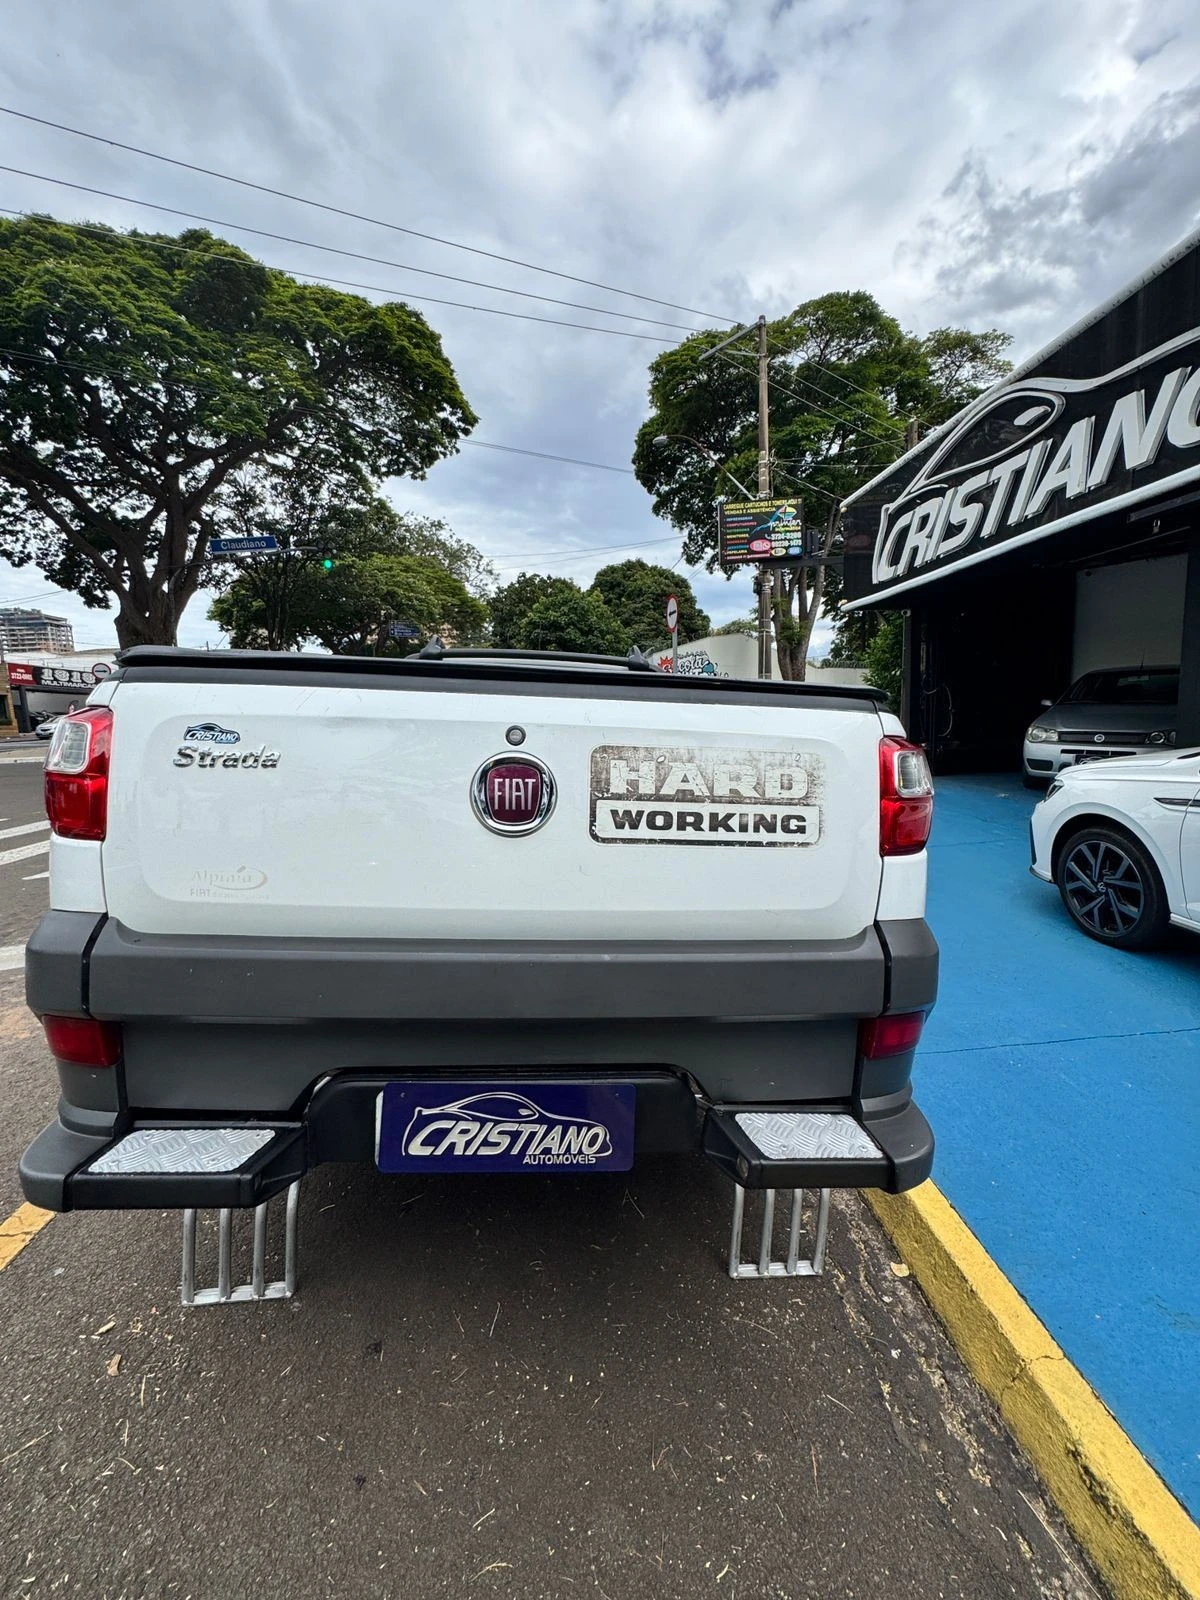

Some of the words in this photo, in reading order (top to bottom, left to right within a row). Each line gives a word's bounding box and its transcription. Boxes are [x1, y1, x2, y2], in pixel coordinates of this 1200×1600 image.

[220, 540, 267, 550] Claudiano
[41, 680, 97, 689] MULTIMARCAS
[186, 730, 238, 741] CRISTIANO
[173, 744, 281, 769] Strada
[610, 758, 809, 799] HARD
[493, 778, 537, 811] FIAT
[610, 808, 807, 835] WORKING
[190, 888, 211, 897] FIAT
[407, 1119, 605, 1156] CRISTIANO
[522, 1152, 596, 1165] AUTOMÓVEIS
